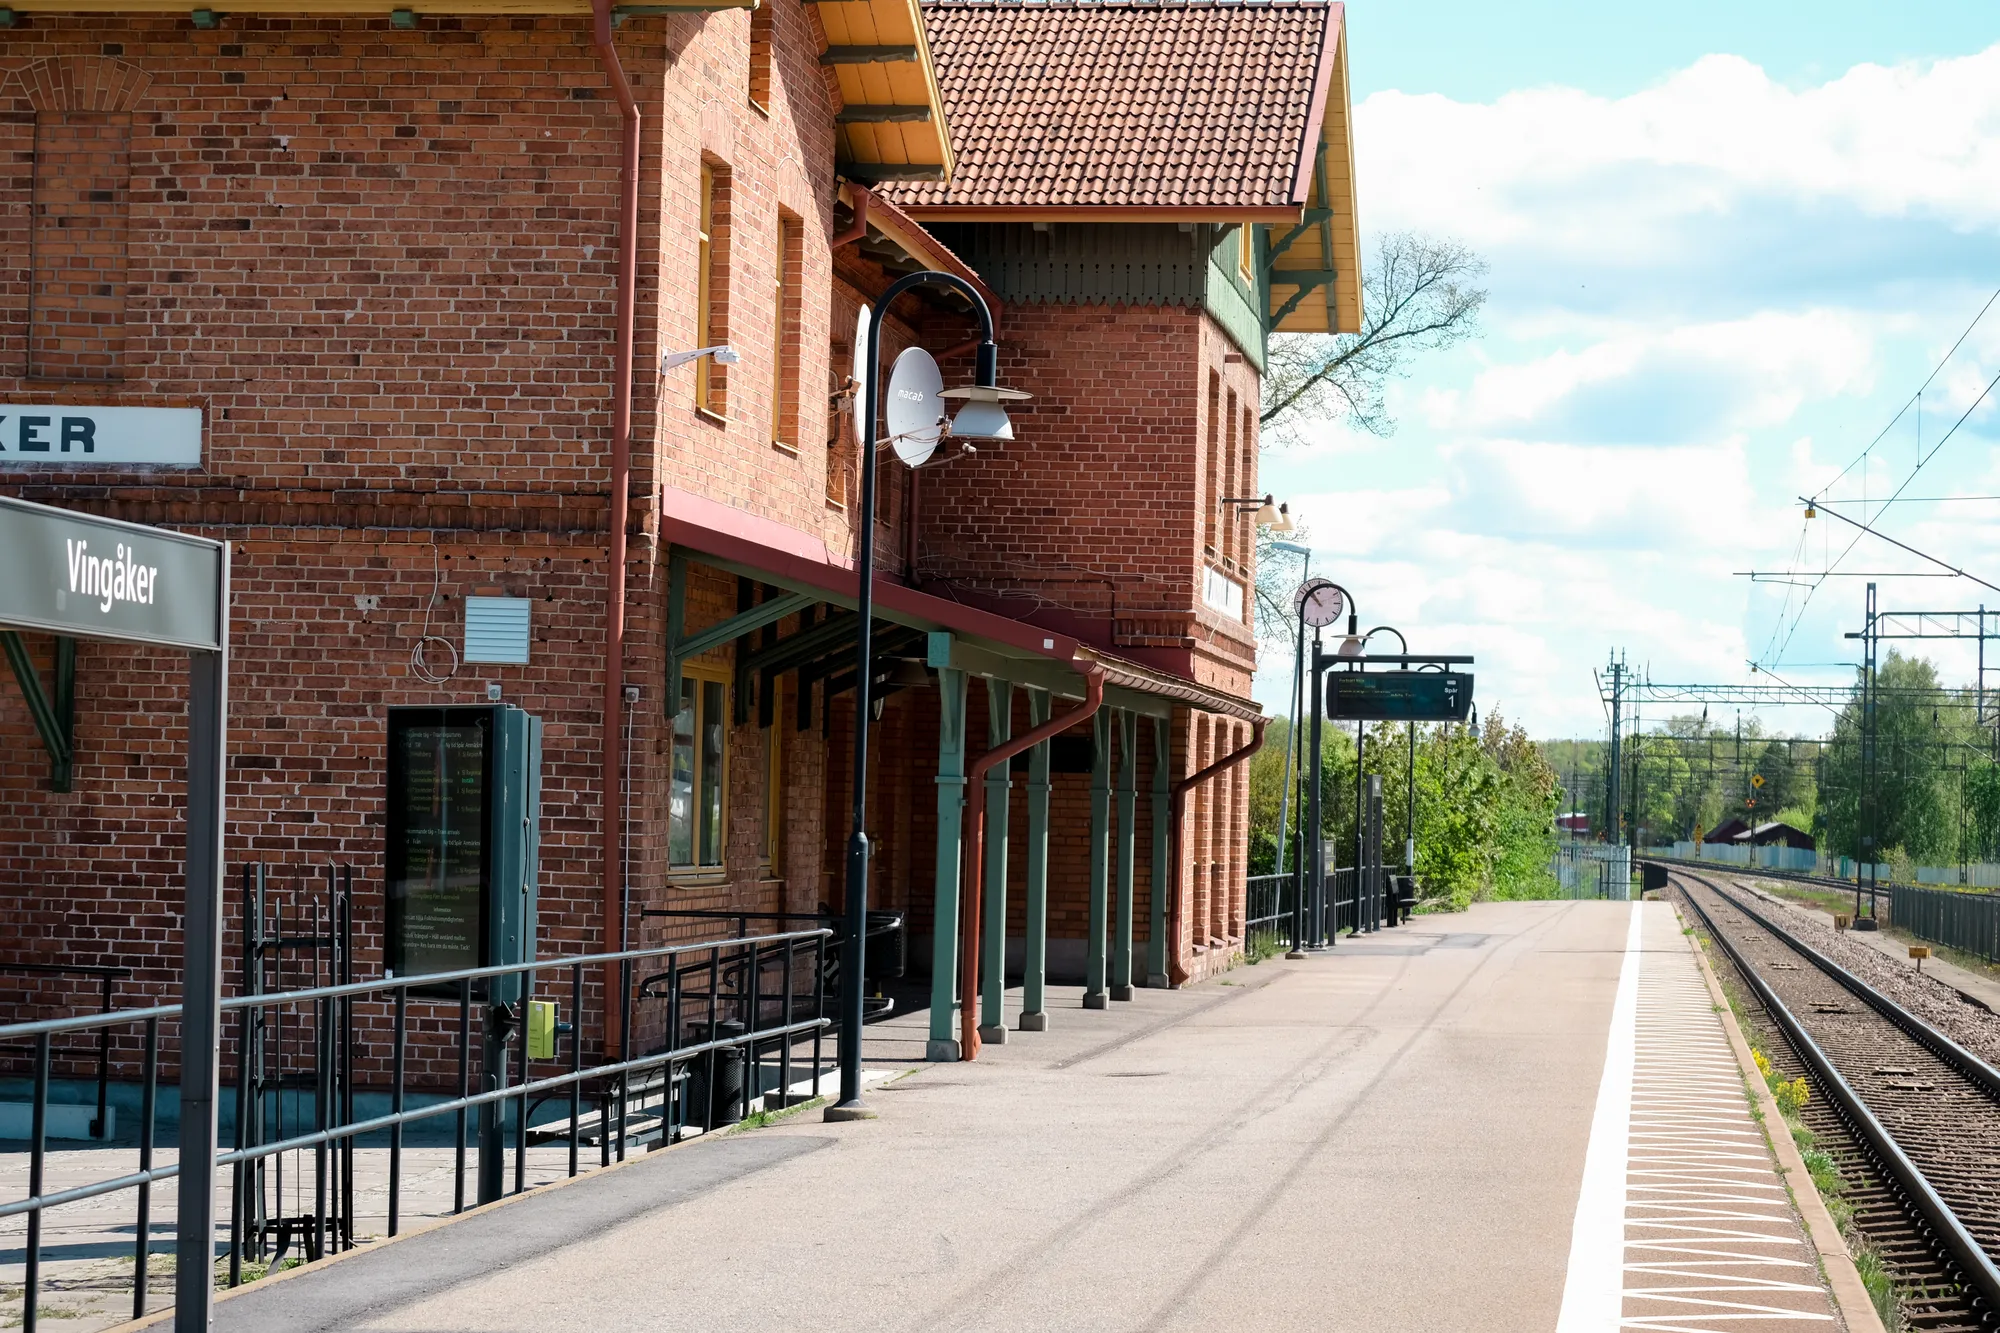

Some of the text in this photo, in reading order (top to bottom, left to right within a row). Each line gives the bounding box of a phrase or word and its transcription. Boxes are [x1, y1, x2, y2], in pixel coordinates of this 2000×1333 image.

[898, 389, 923, 401] macab
[0, 416, 96, 452] ER
[67, 539, 157, 613] Vingåker
[1448, 696, 1454, 708] 1
[1839, 918, 1847, 928] U
